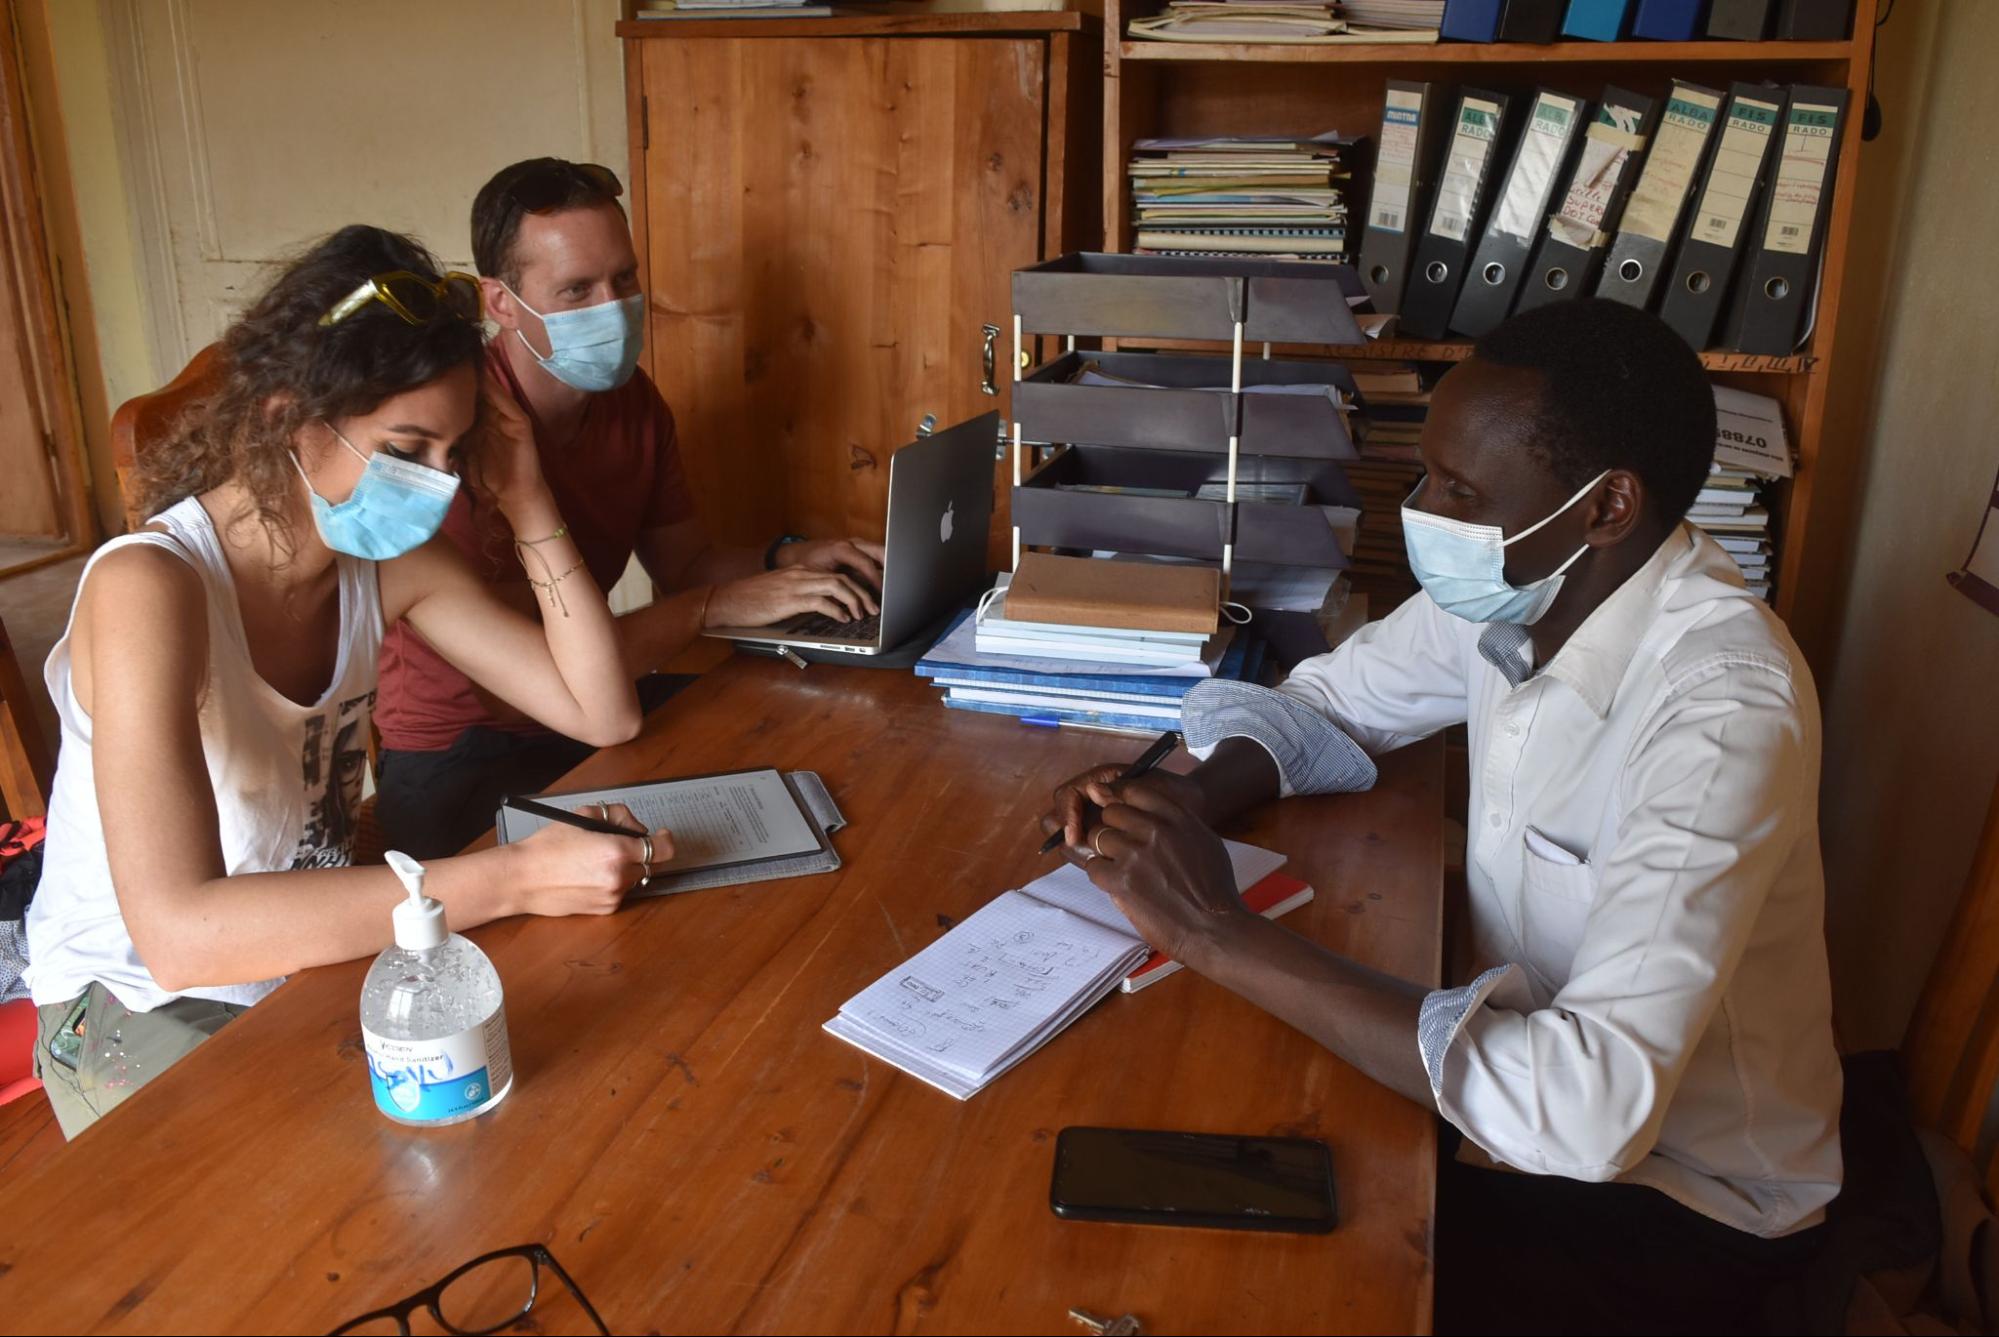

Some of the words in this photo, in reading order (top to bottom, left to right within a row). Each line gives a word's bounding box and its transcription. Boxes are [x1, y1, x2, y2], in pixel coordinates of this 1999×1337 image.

[1671, 103, 1709, 121] ALBA
[1536, 119, 1567, 135] RADO
[1668, 112, 1707, 130] RADO
[1732, 119, 1766, 132] RADO
[1793, 125, 1827, 136] RADO
